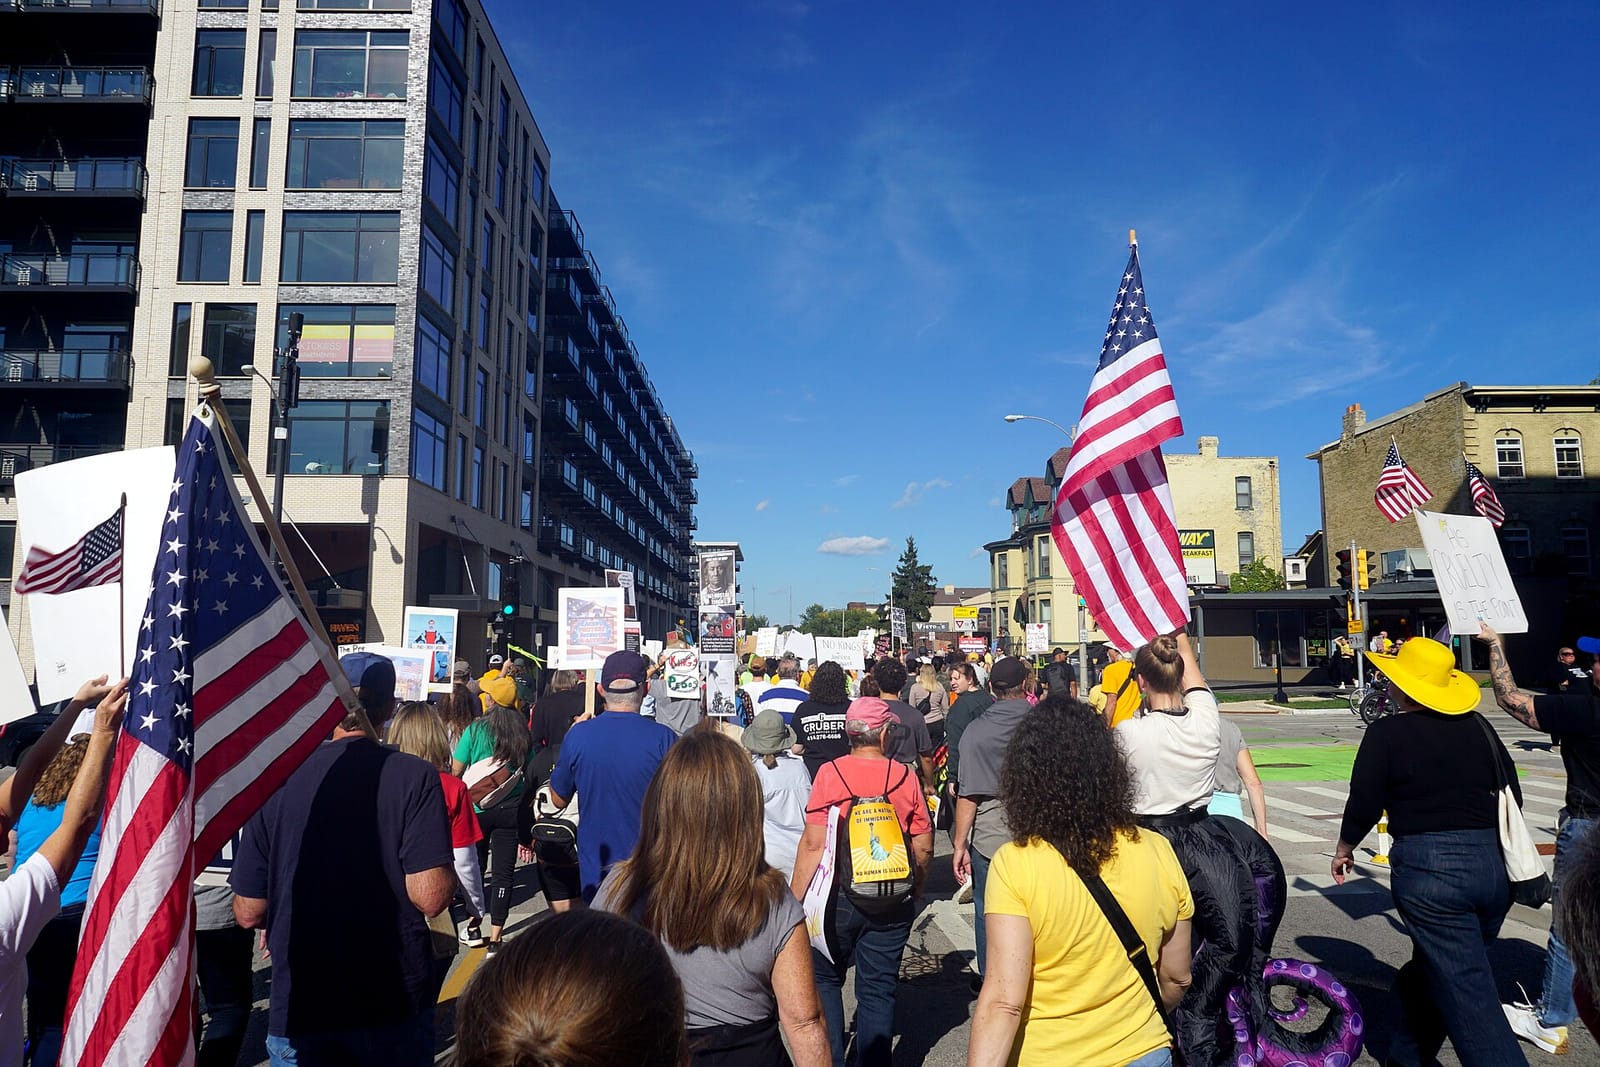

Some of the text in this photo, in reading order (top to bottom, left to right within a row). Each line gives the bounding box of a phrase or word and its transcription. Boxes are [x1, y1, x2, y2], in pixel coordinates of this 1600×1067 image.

[1433, 549, 1503, 595] CRUELTY
[1454, 600, 1467, 621] IS
[1490, 597, 1519, 619] POINT
[822, 639, 835, 649] NO
[838, 640, 861, 651] KINGS
[803, 721, 845, 733] GRUBER
